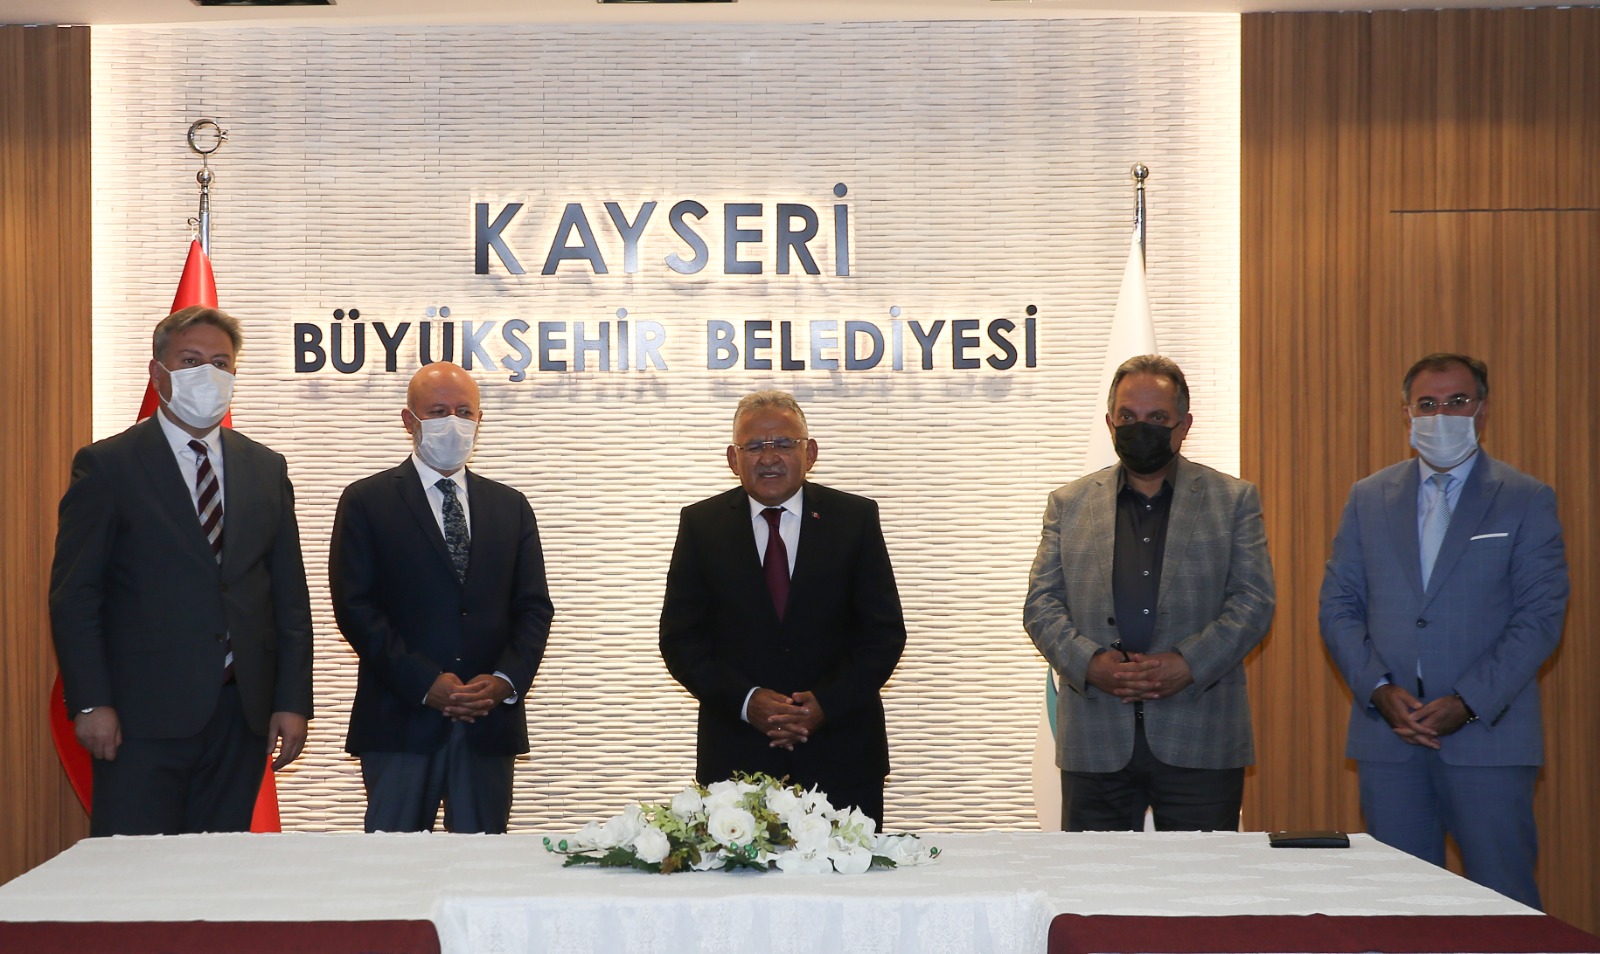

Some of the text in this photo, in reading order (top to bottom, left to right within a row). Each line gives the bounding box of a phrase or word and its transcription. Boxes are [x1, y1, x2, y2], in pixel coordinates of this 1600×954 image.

[475, 183, 850, 276] KAYSERİ
[294, 305, 1038, 382] BÜYÜKŞEHİR BELEDİYESİ
